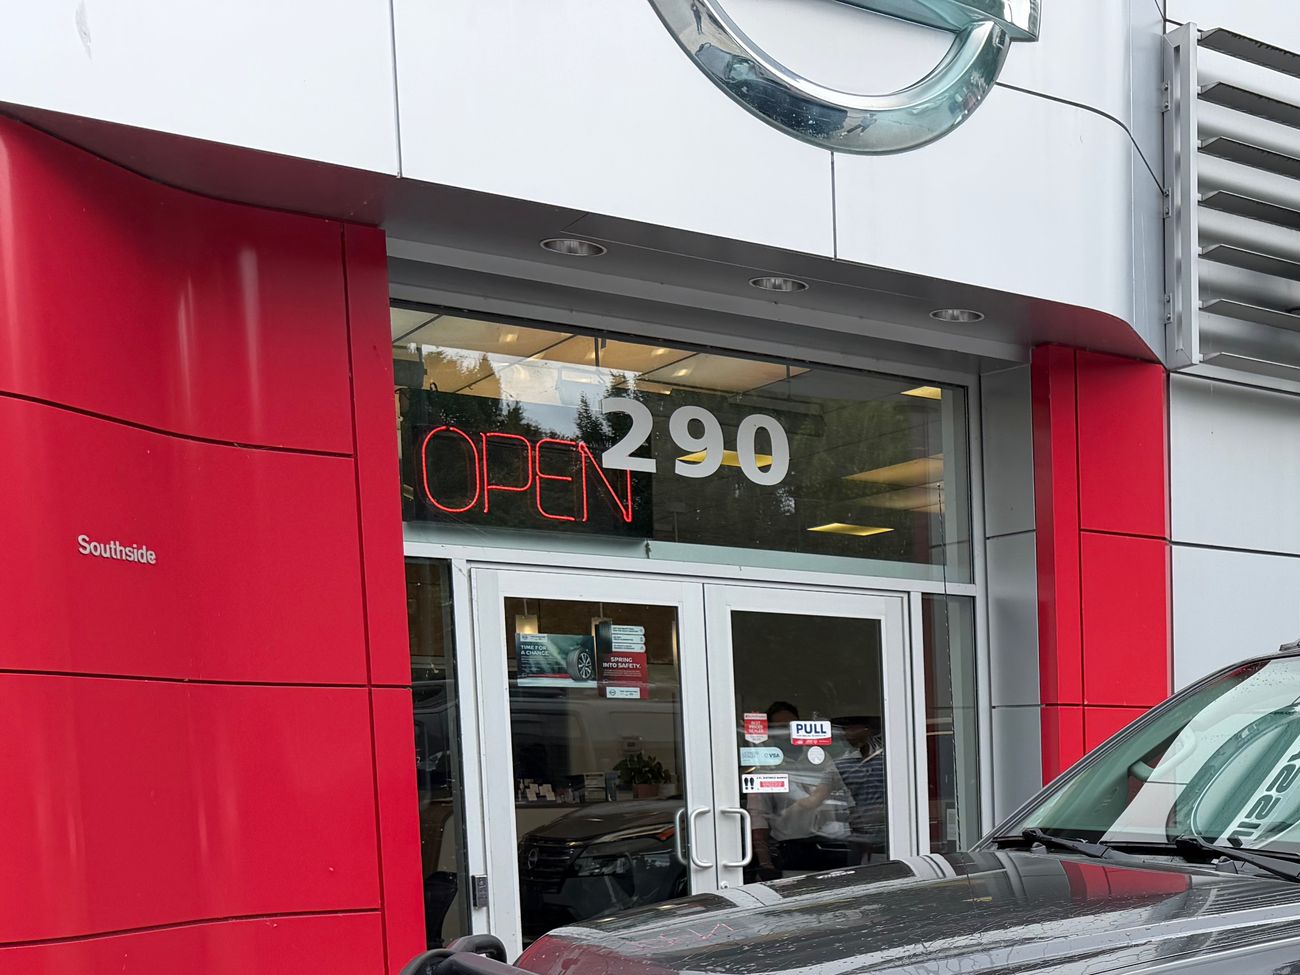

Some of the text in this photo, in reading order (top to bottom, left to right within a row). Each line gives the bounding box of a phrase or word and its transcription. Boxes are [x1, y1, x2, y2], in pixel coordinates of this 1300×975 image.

[602, 397, 791, 487] 290
[421, 425, 634, 523] OPEN
[77, 534, 157, 565] Southside
[796, 723, 827, 734] PULL
